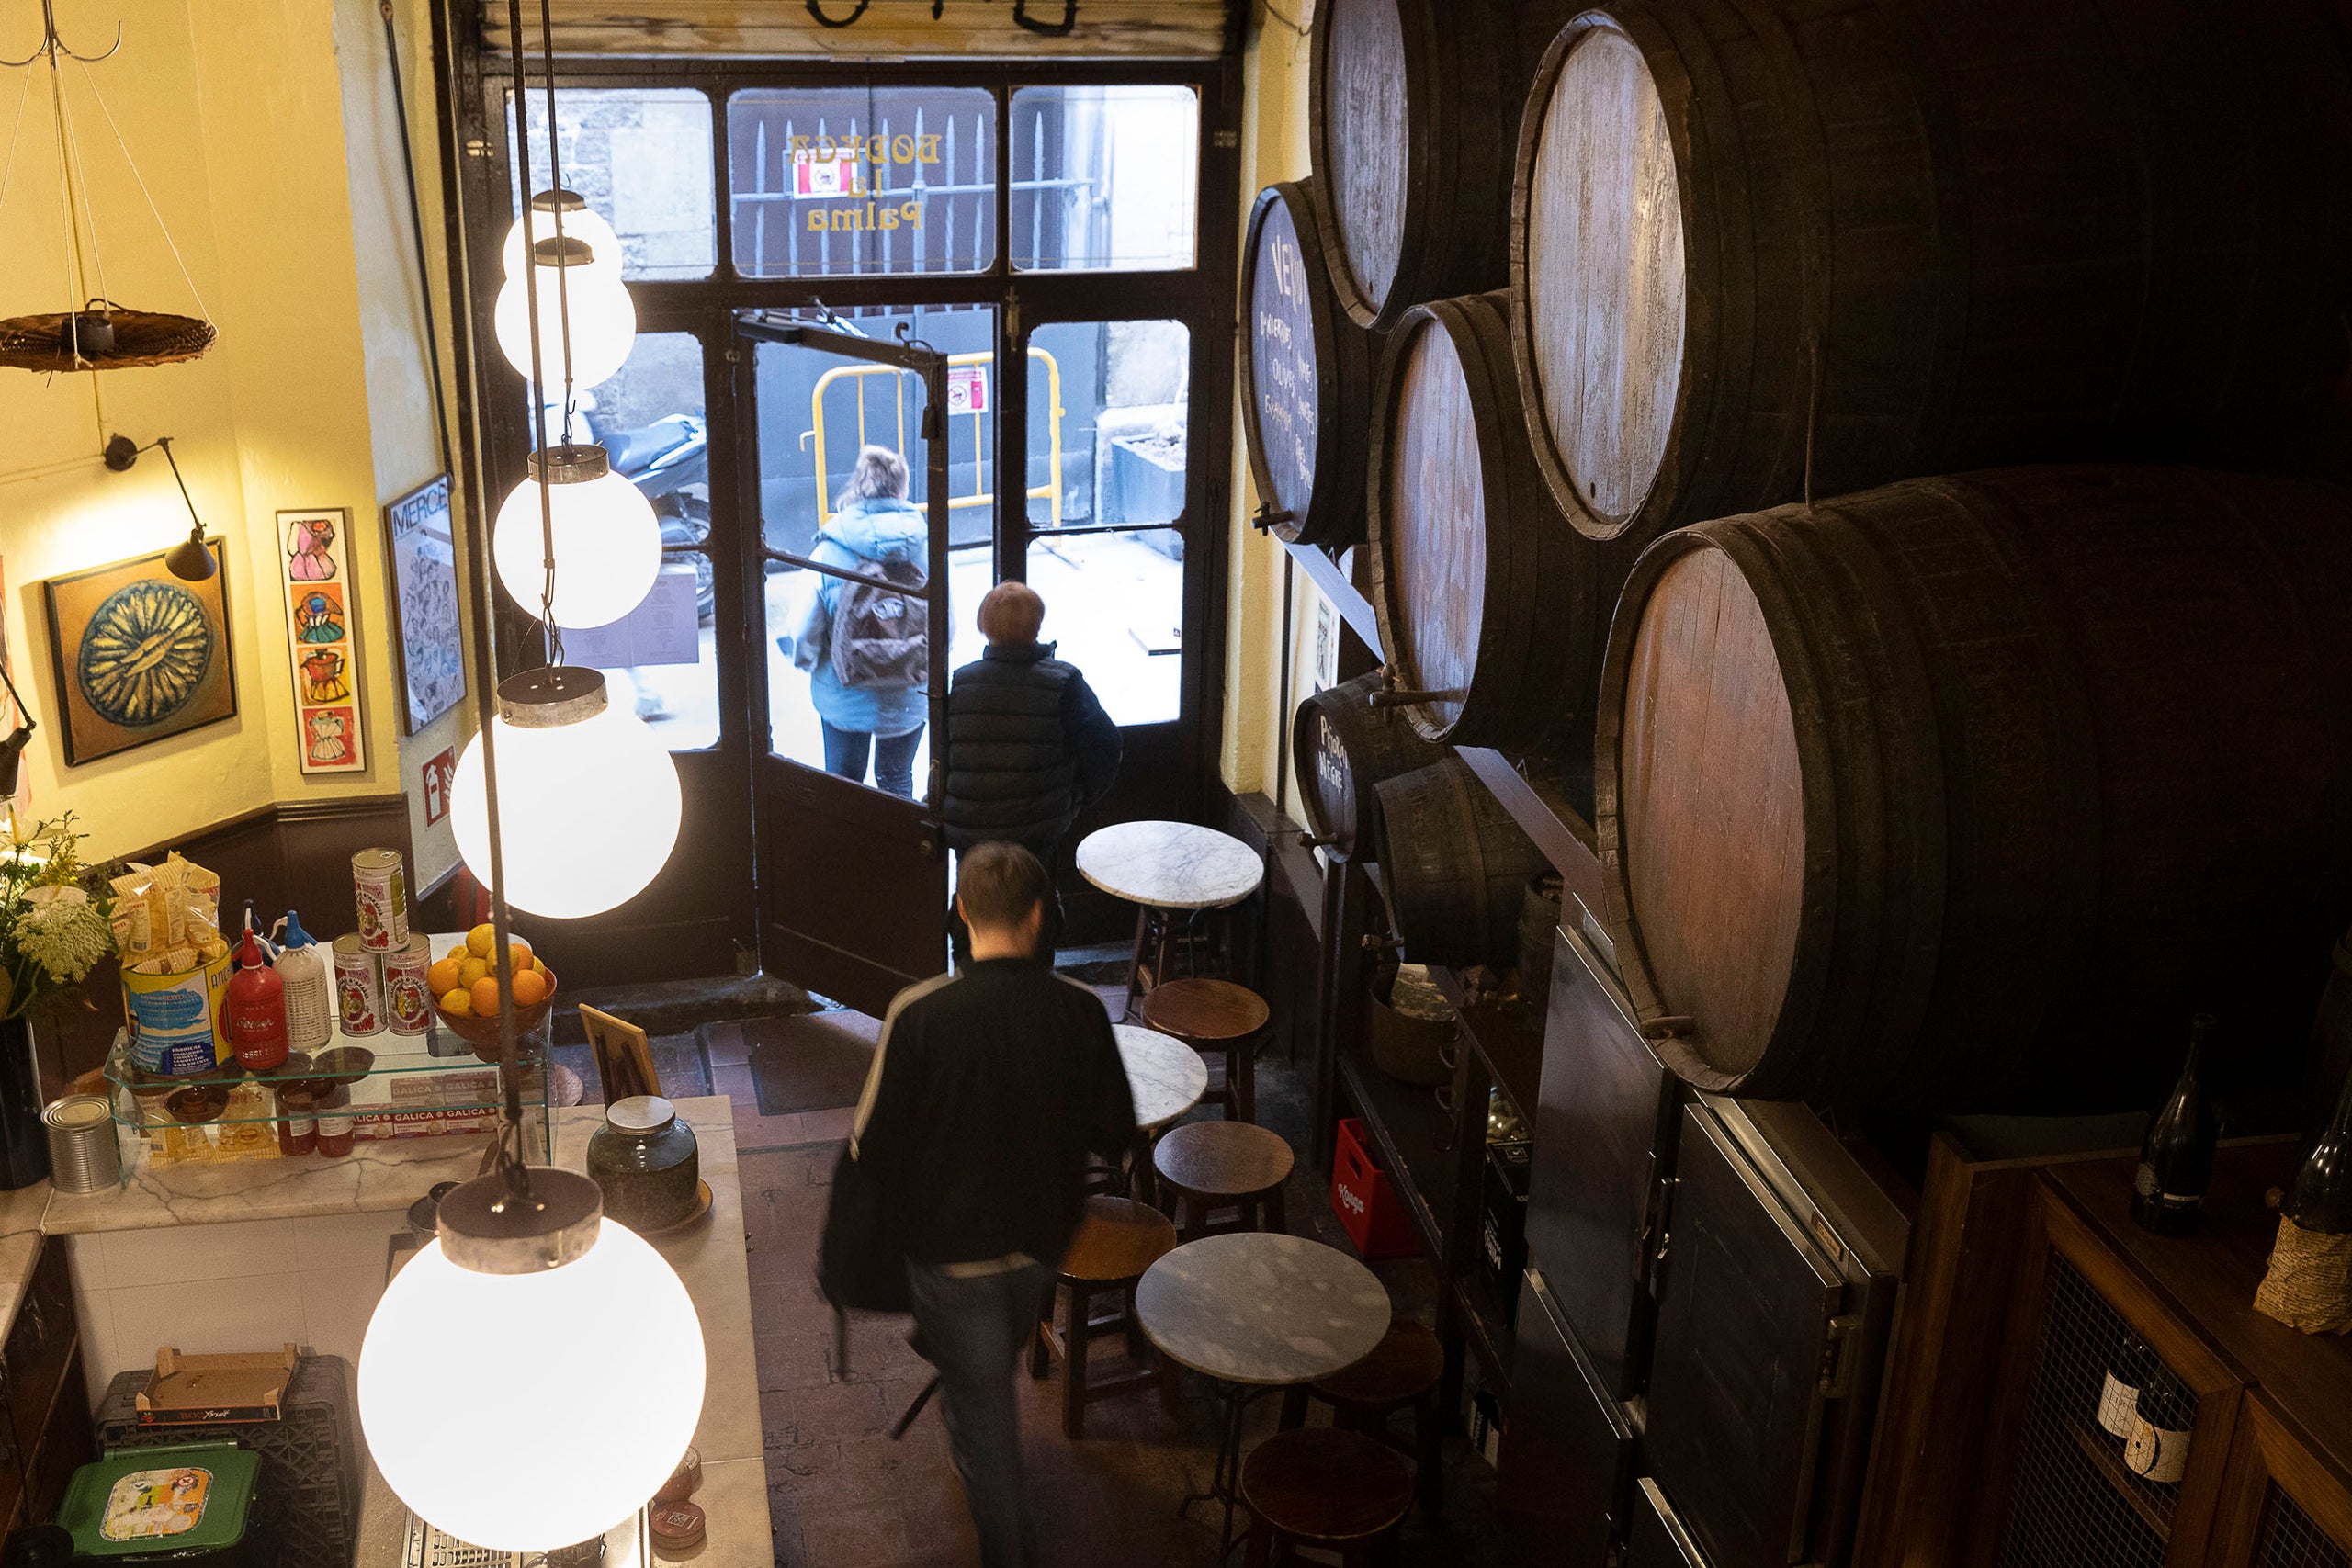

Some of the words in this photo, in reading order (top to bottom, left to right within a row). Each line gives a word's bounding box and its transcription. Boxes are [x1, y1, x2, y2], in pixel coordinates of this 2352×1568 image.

[446, 1080, 486, 1090] GALICA
[392, 1085, 432, 1096] GALICA
[395, 1111, 434, 1122] GALICA
[447, 1108, 486, 1117] GALICA
[353, 1114, 380, 1122] ALICA
